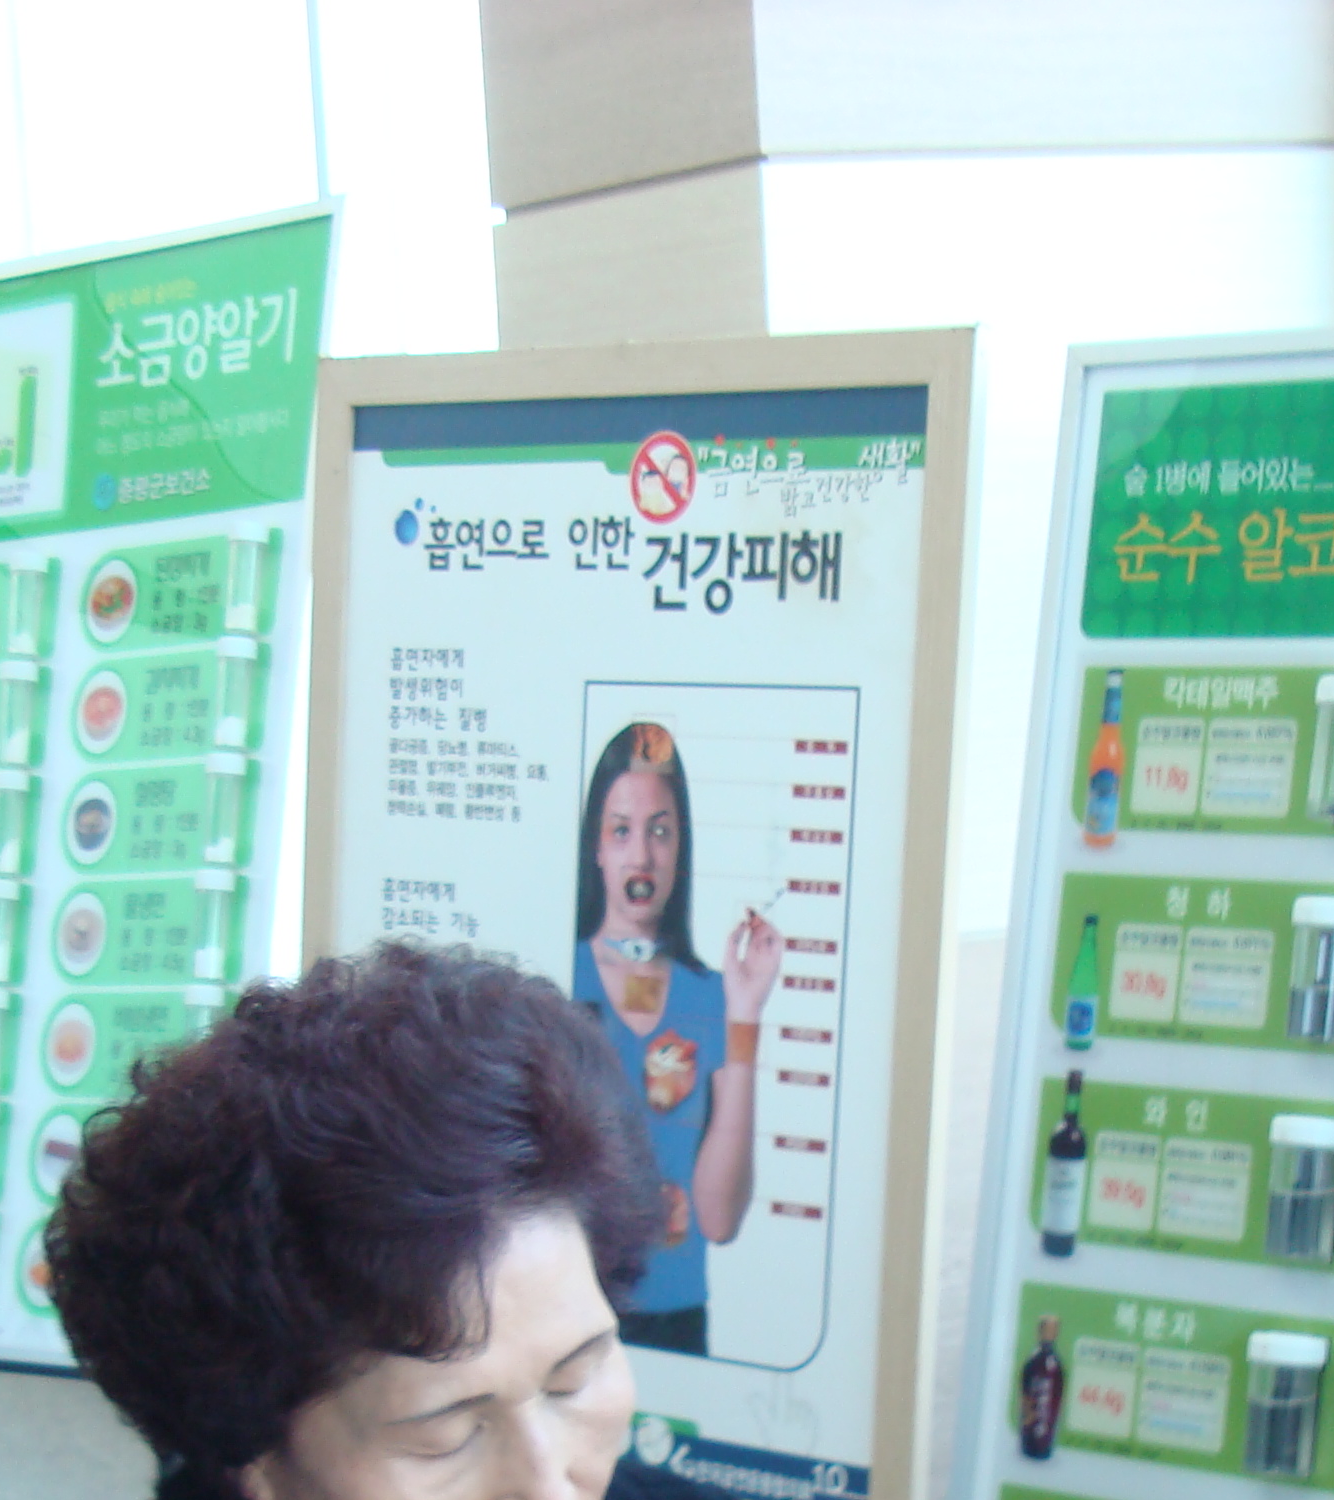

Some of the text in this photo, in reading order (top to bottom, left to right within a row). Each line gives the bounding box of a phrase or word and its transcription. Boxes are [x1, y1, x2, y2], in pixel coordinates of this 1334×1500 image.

[96, 287, 298, 388] 소금양알기
[1124, 462, 1149, 497] 술
[1113, 508, 1222, 585] 순수
[424, 515, 844, 613] 흡연으로 인한 건강피해
[390, 647, 465, 672] 흡연자에게
[389, 676, 464, 702] 발생위험이
[1163, 675, 1280, 710] 칵테일맥주
[388, 705, 488, 733] 증가하는 질병
[381, 877, 456, 903] 흡연자에게
[381, 906, 481, 938] 감소되는 기능
[811, 1462, 849, 1495] 10
